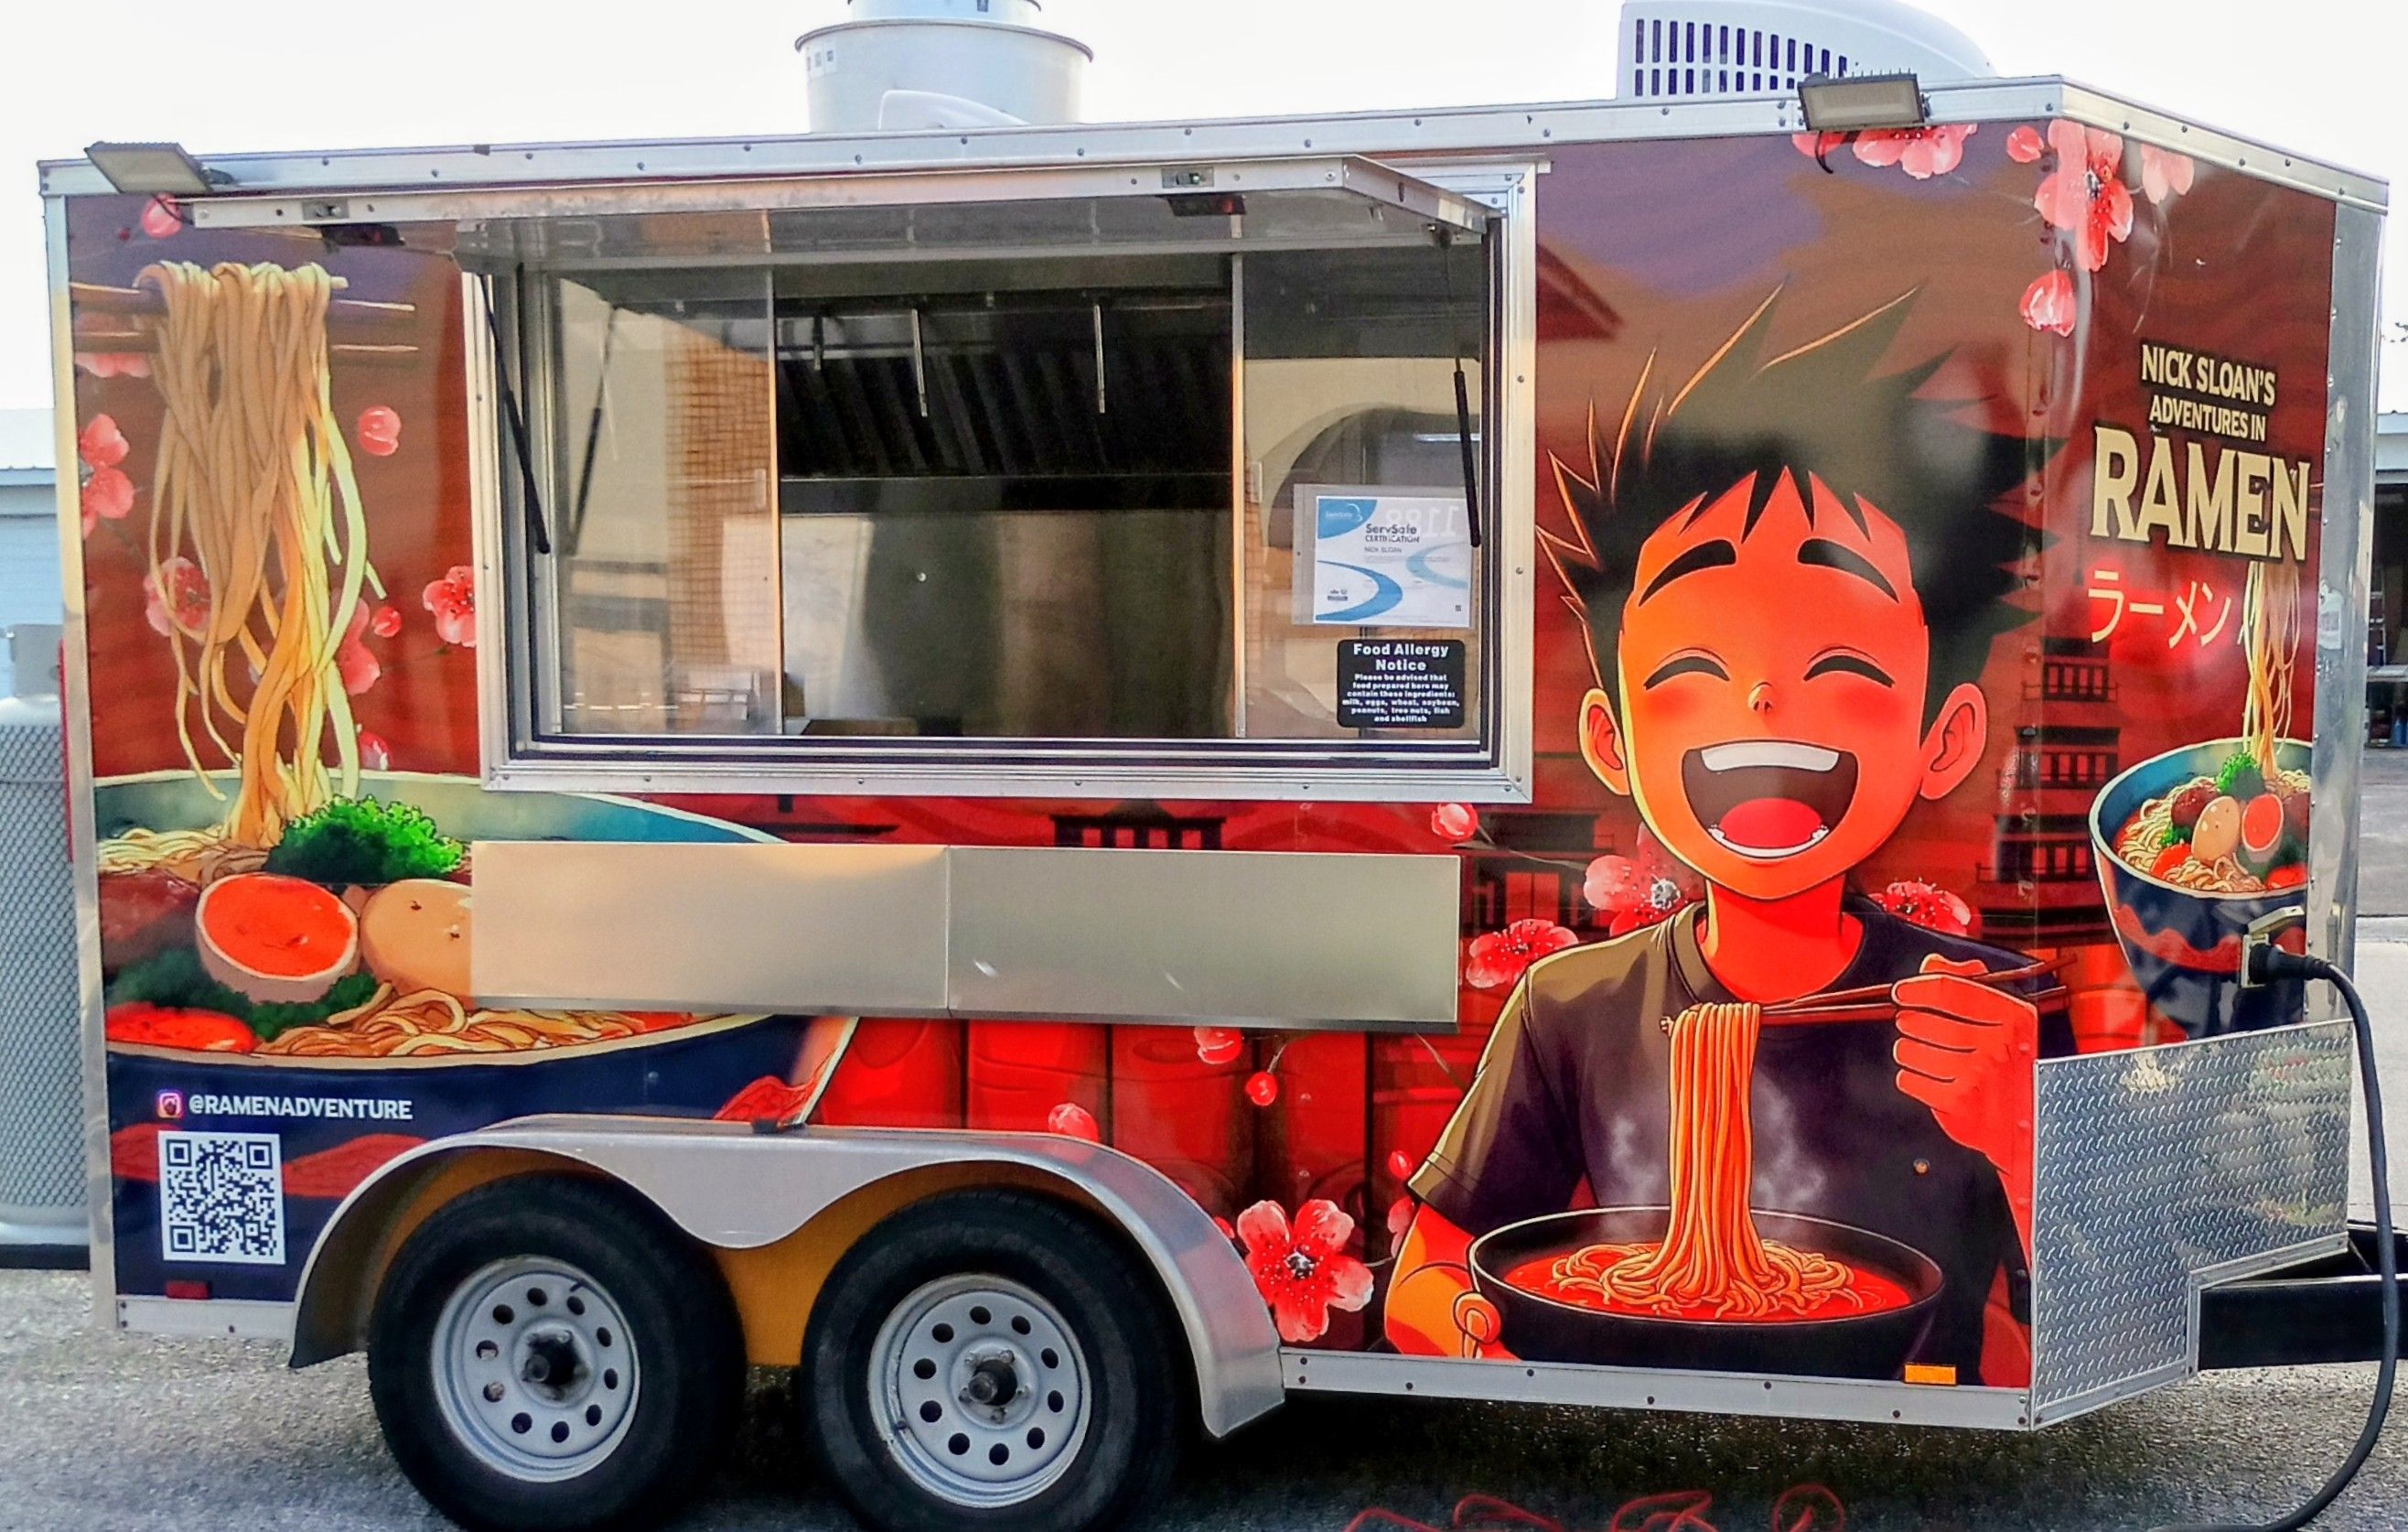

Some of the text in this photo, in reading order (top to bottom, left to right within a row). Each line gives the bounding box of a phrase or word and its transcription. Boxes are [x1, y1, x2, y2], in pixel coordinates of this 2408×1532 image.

[2142, 344, 2276, 406] NICK SLOAN'S
[2149, 394, 2266, 441] ADVENTURES IN
[2091, 426, 2311, 561] RAMEN
[1366, 523, 1417, 534] ServSafe
[2088, 569, 2232, 649] ラーメン
[1353, 643, 1449, 658] Food Allergy
[1375, 659, 1427, 671] Notice
[1372, 682, 1410, 691] prepared
[188, 1095, 414, 1120] @RAMENADVENTURE
